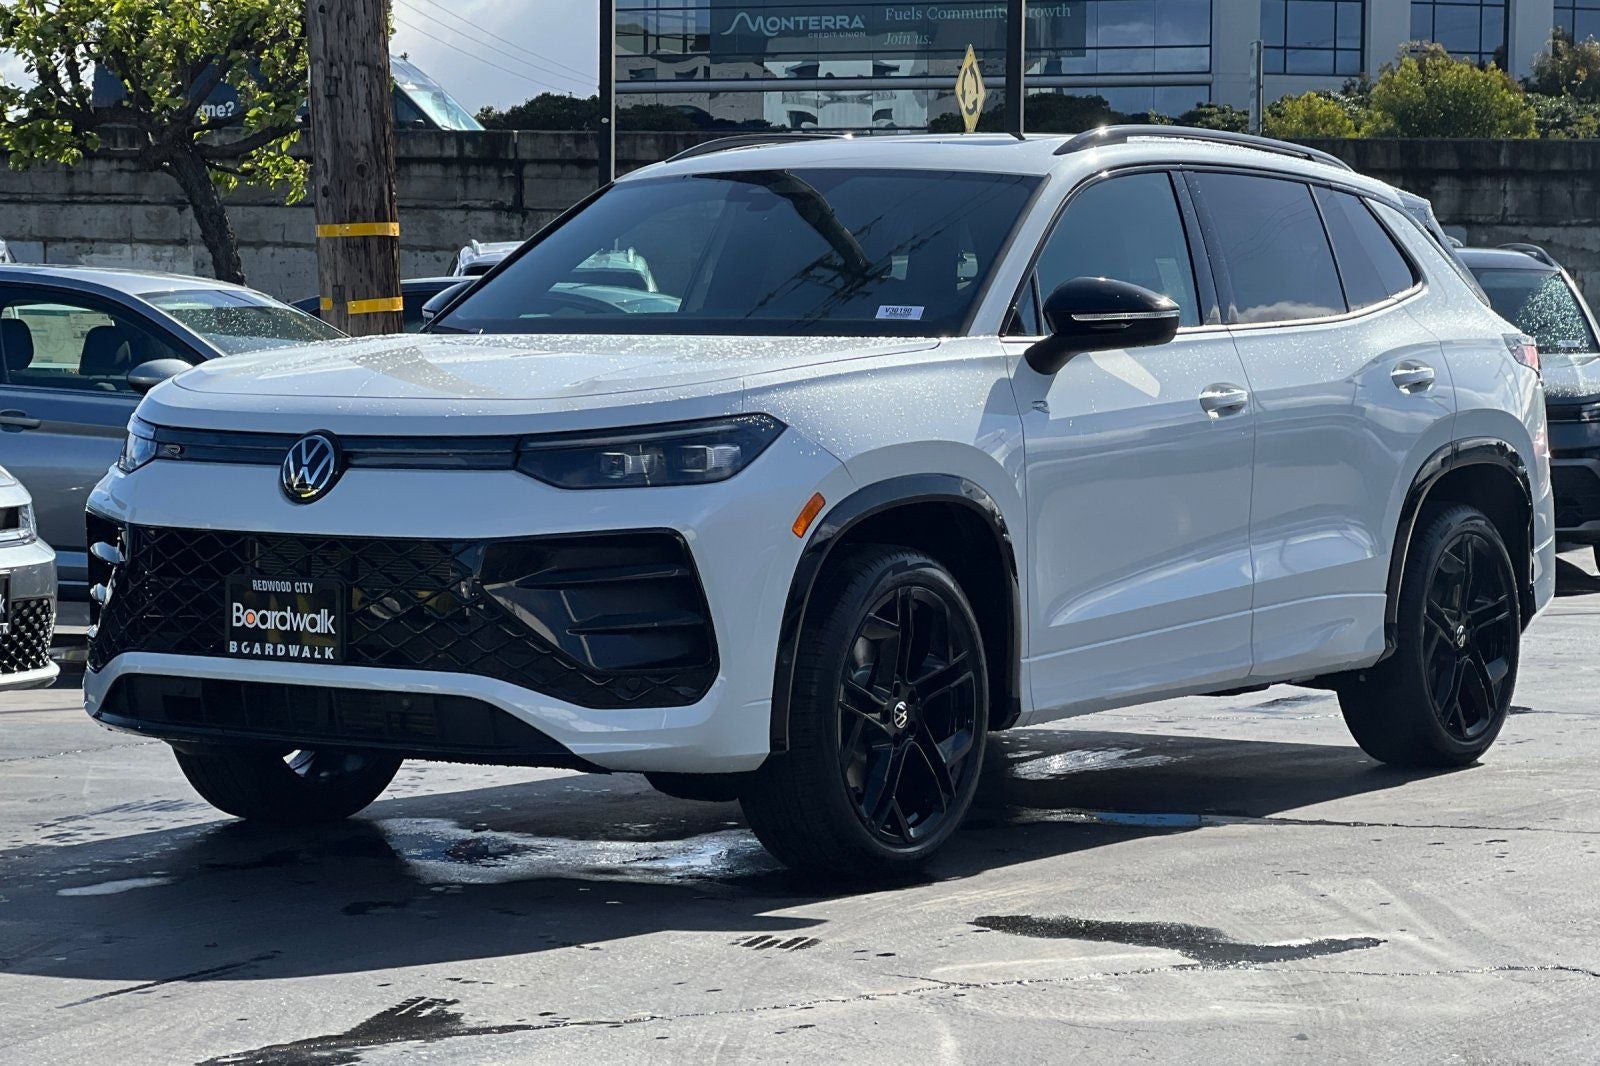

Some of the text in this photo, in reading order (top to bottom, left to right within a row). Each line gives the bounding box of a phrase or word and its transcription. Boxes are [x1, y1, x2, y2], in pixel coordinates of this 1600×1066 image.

[885, 7, 922, 21] Fuels
[1025, 3, 1072, 18] rowth
[720, 12, 865, 36] MONTERRA
[884, 32, 932, 45] Join us.
[252, 579, 314, 594] REDWOOD CITY
[232, 601, 336, 635] Boardwalk
